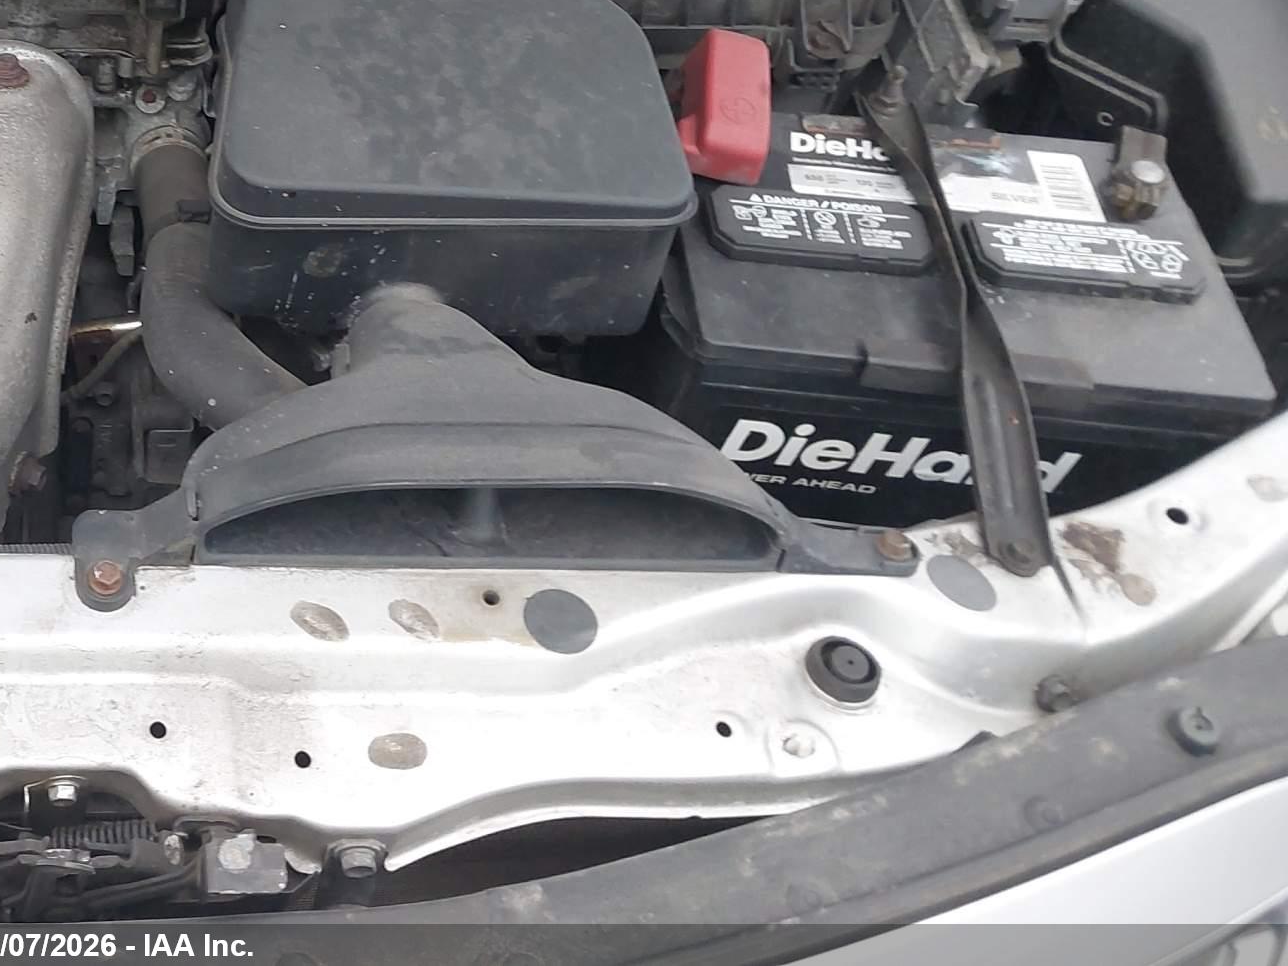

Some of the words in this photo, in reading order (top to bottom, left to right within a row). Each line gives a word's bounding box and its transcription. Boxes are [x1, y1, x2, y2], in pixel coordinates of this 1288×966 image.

[763, 195, 819, 208] DANGER
[831, 201, 883, 214] POISON
[792, 477, 877, 494] AHEAD
